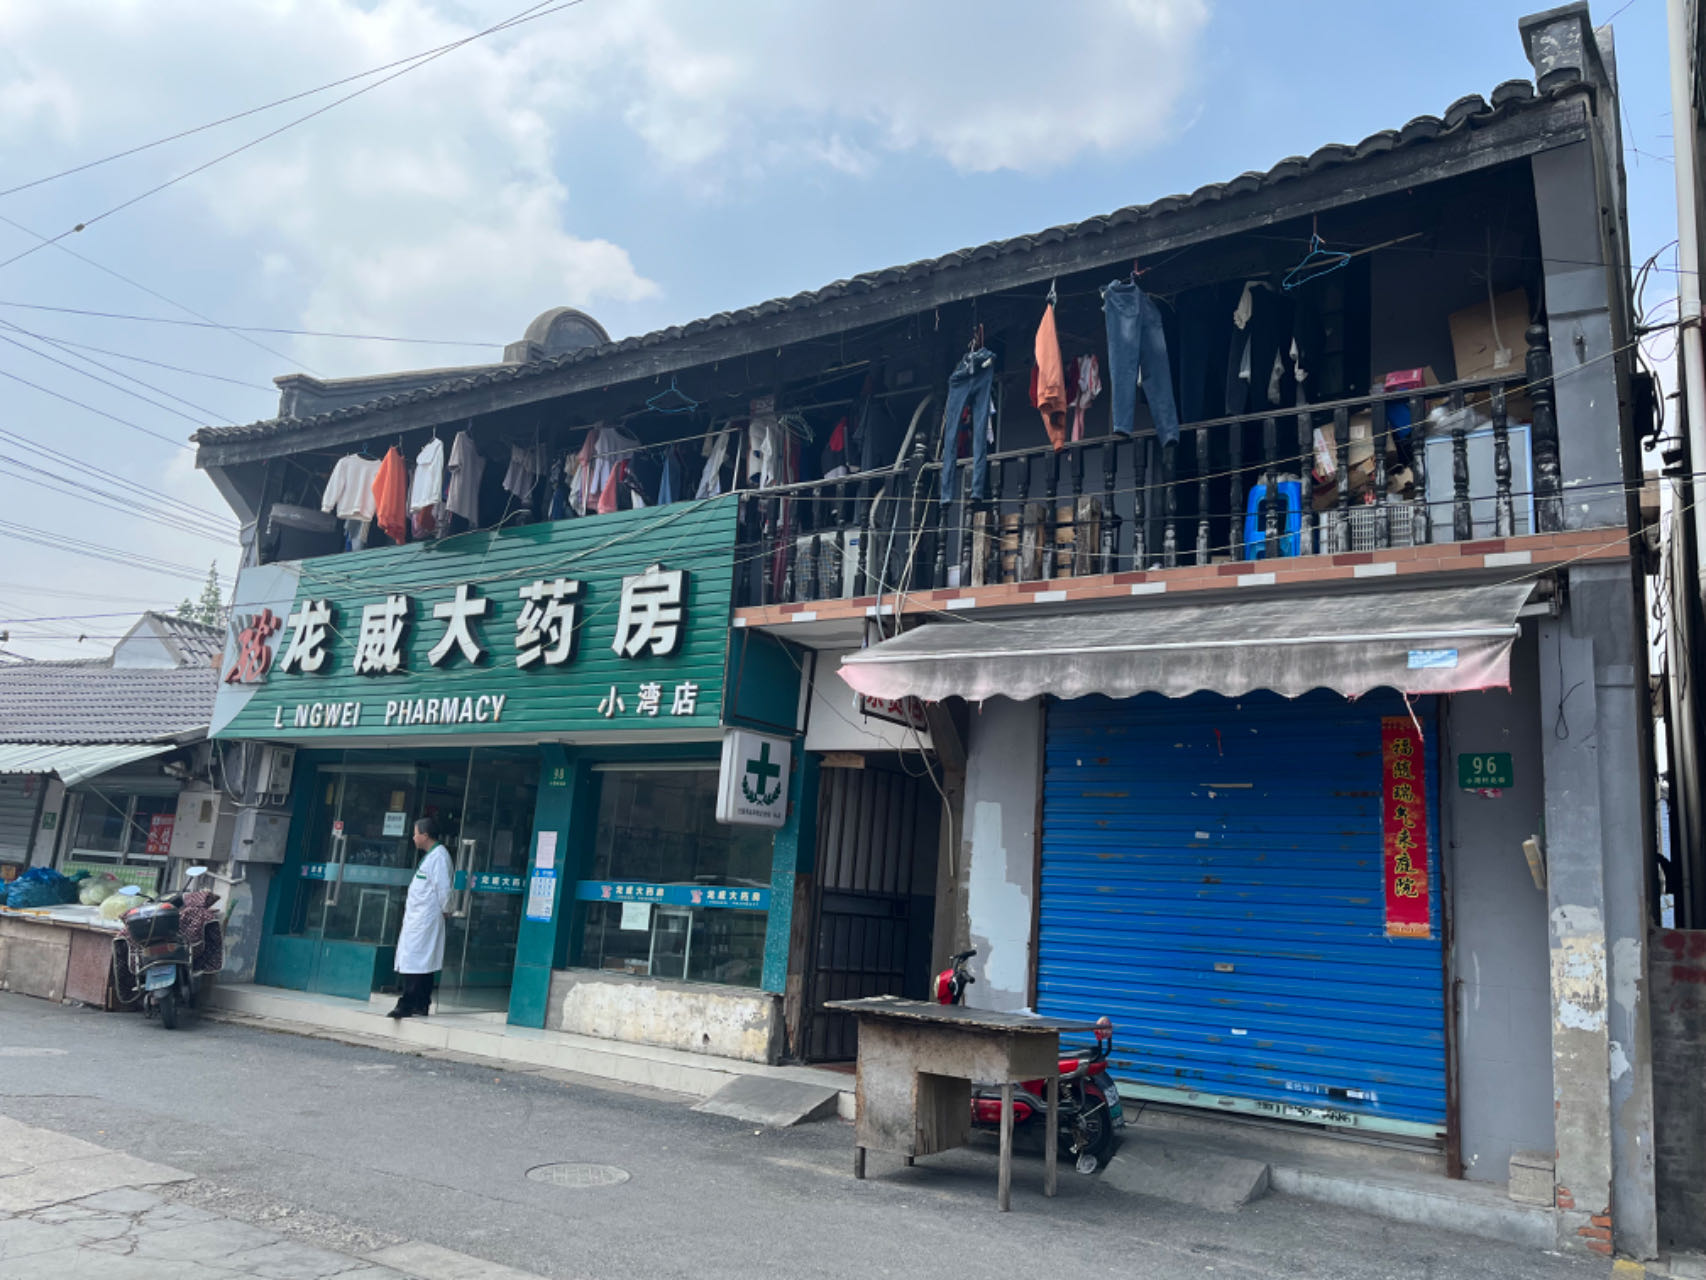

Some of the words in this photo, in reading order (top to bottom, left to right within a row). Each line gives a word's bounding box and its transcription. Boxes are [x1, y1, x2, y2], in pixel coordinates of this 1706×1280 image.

[280, 563, 687, 674] 龙威大药房
[384, 694, 506, 726] PHARMACY
[598, 681, 699, 717] 小湾店
[1472, 756, 1497, 774] 96
